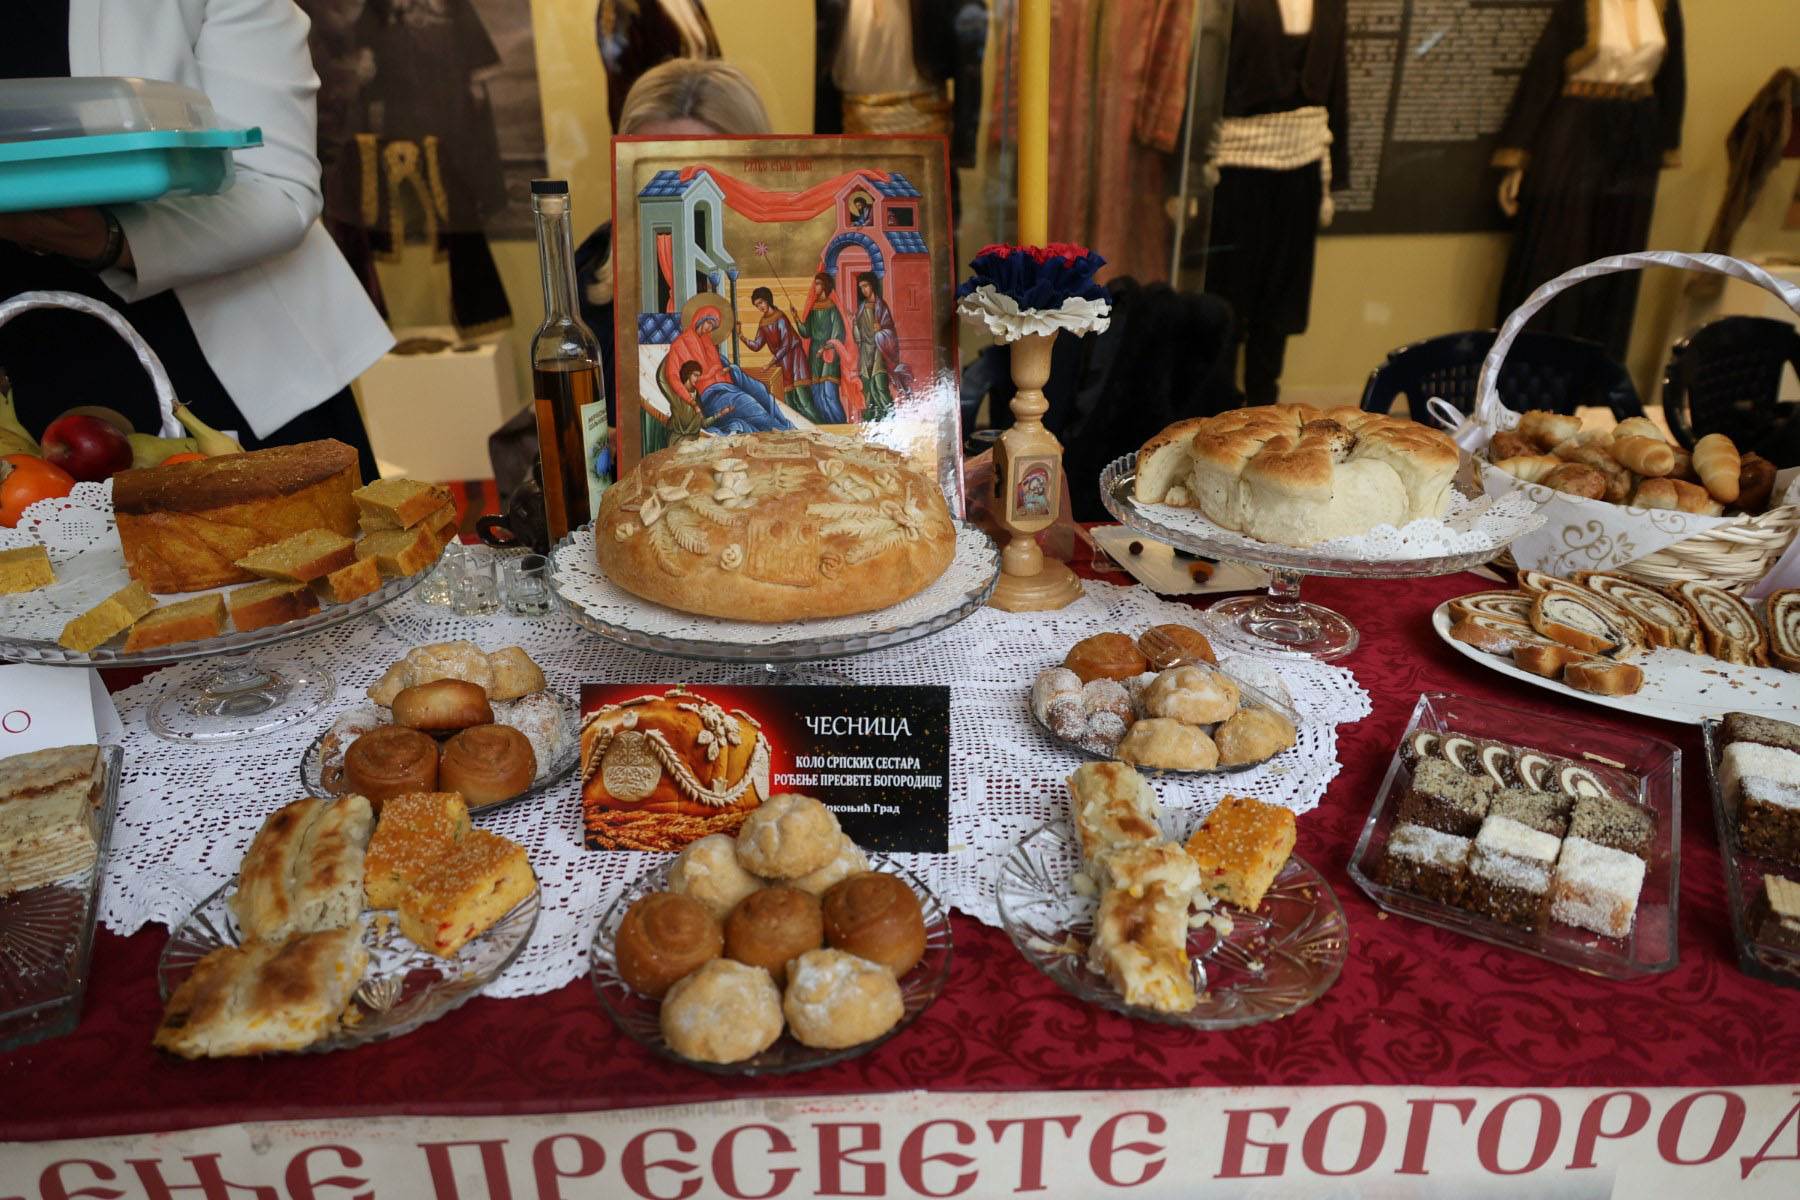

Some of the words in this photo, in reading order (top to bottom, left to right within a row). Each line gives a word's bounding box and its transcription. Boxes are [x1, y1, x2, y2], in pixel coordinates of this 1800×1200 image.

[805, 716, 912, 741] ЧЕСНИЦА
[796, 756, 825, 769] КОЛО
[827, 756, 874, 769] СРПСКИХ
[875, 757, 921, 770] СЕСТАРА
[774, 773, 818, 786] РОЂЕЊЕ
[820, 774, 872, 787] ПРЕСВЕТЕ
[873, 775, 943, 790] БОГОРОДИЦЕ
[822, 802, 871, 813] ркоњић
[873, 803, 900, 815] Град
[0, 1144, 375, 1200] ЕЊЕ
